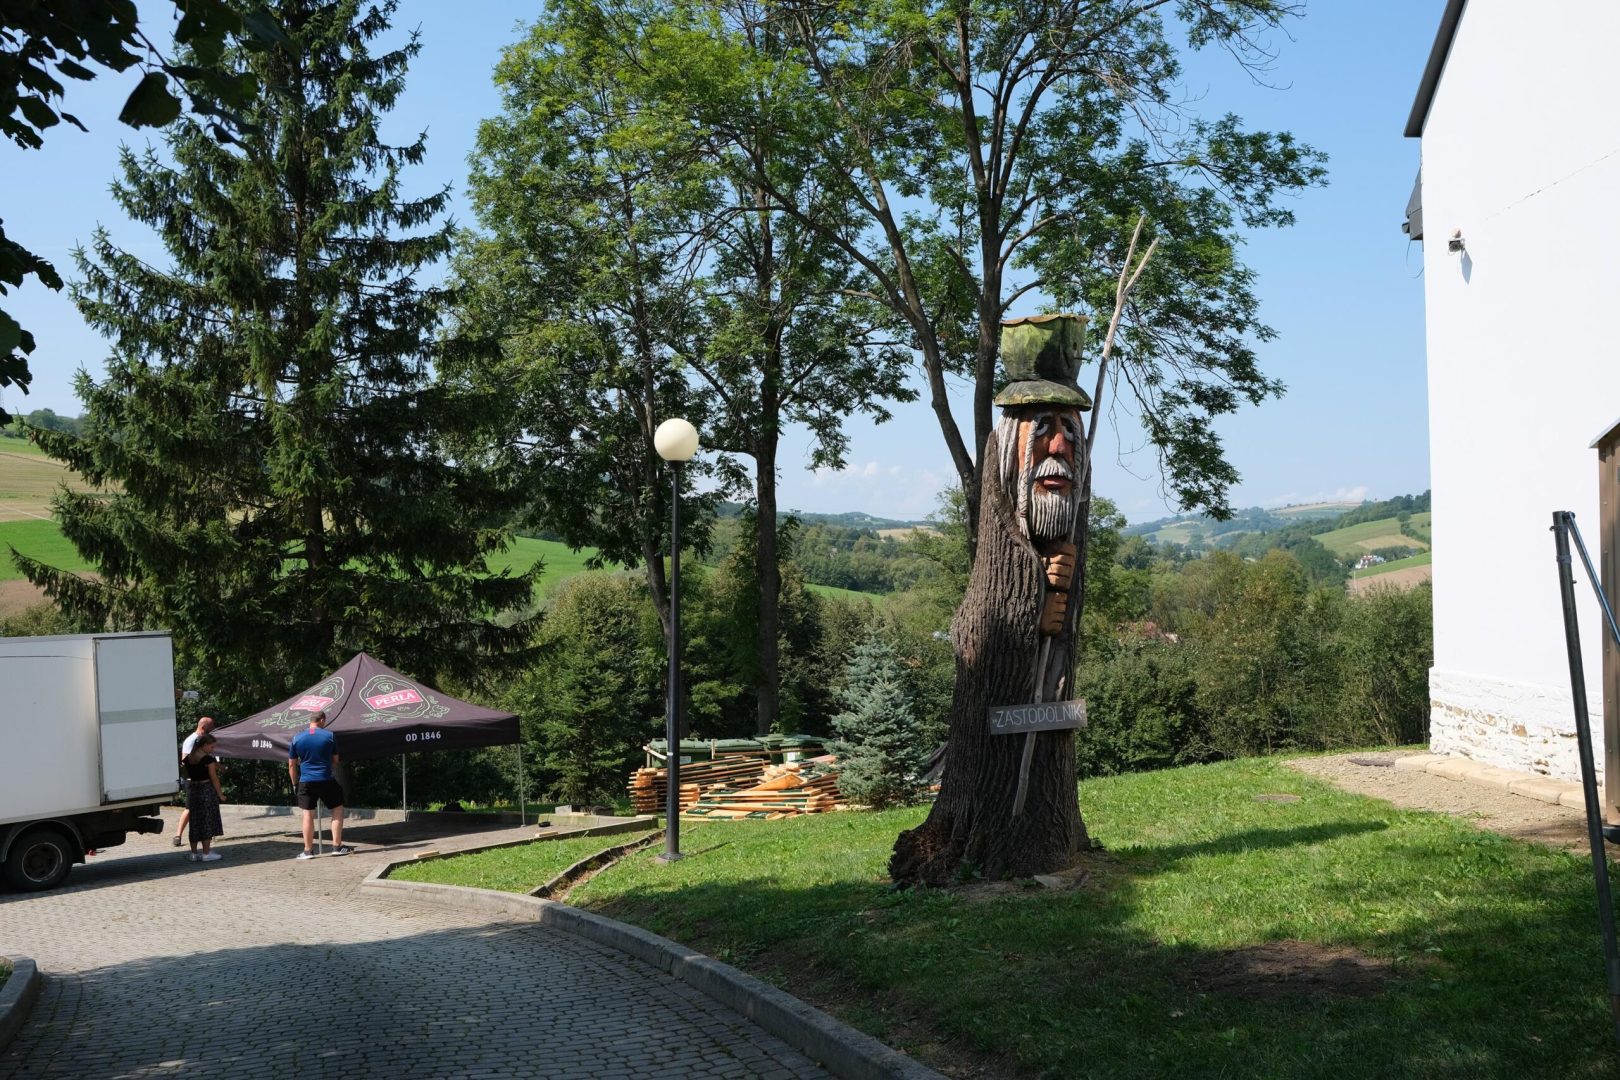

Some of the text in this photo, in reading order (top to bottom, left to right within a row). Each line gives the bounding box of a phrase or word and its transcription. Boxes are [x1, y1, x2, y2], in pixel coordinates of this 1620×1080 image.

[405, 730, 441, 742] OD 1846
[260, 739, 273, 749] 1846
